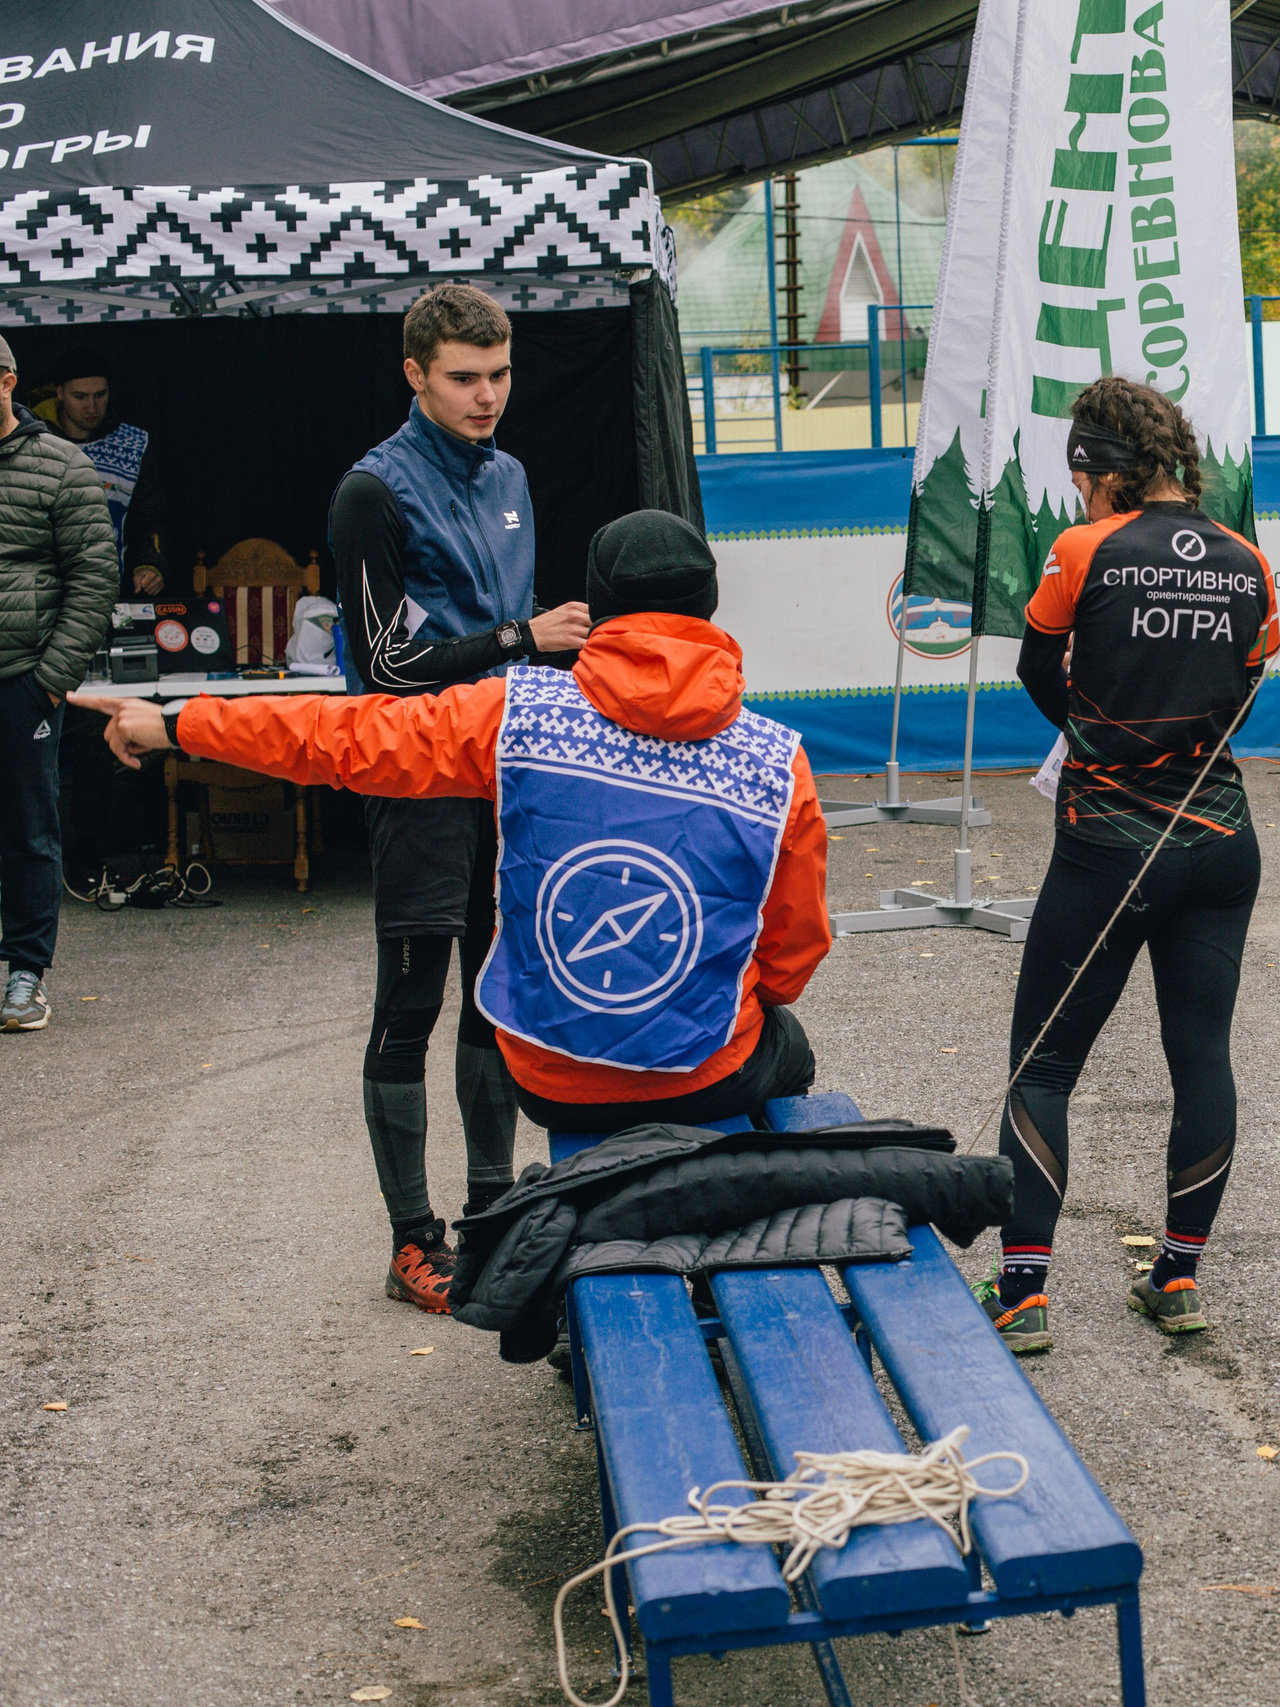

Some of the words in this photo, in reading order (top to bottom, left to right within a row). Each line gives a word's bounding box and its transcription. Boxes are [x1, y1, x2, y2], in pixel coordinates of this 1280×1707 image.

[0, 31, 215, 83] ВАНИЯ
[1103, 566, 1258, 596] СПОРТИВНОЕ
[1146, 590, 1231, 604] ориентирование
[1131, 606, 1233, 643] ЮГРА
